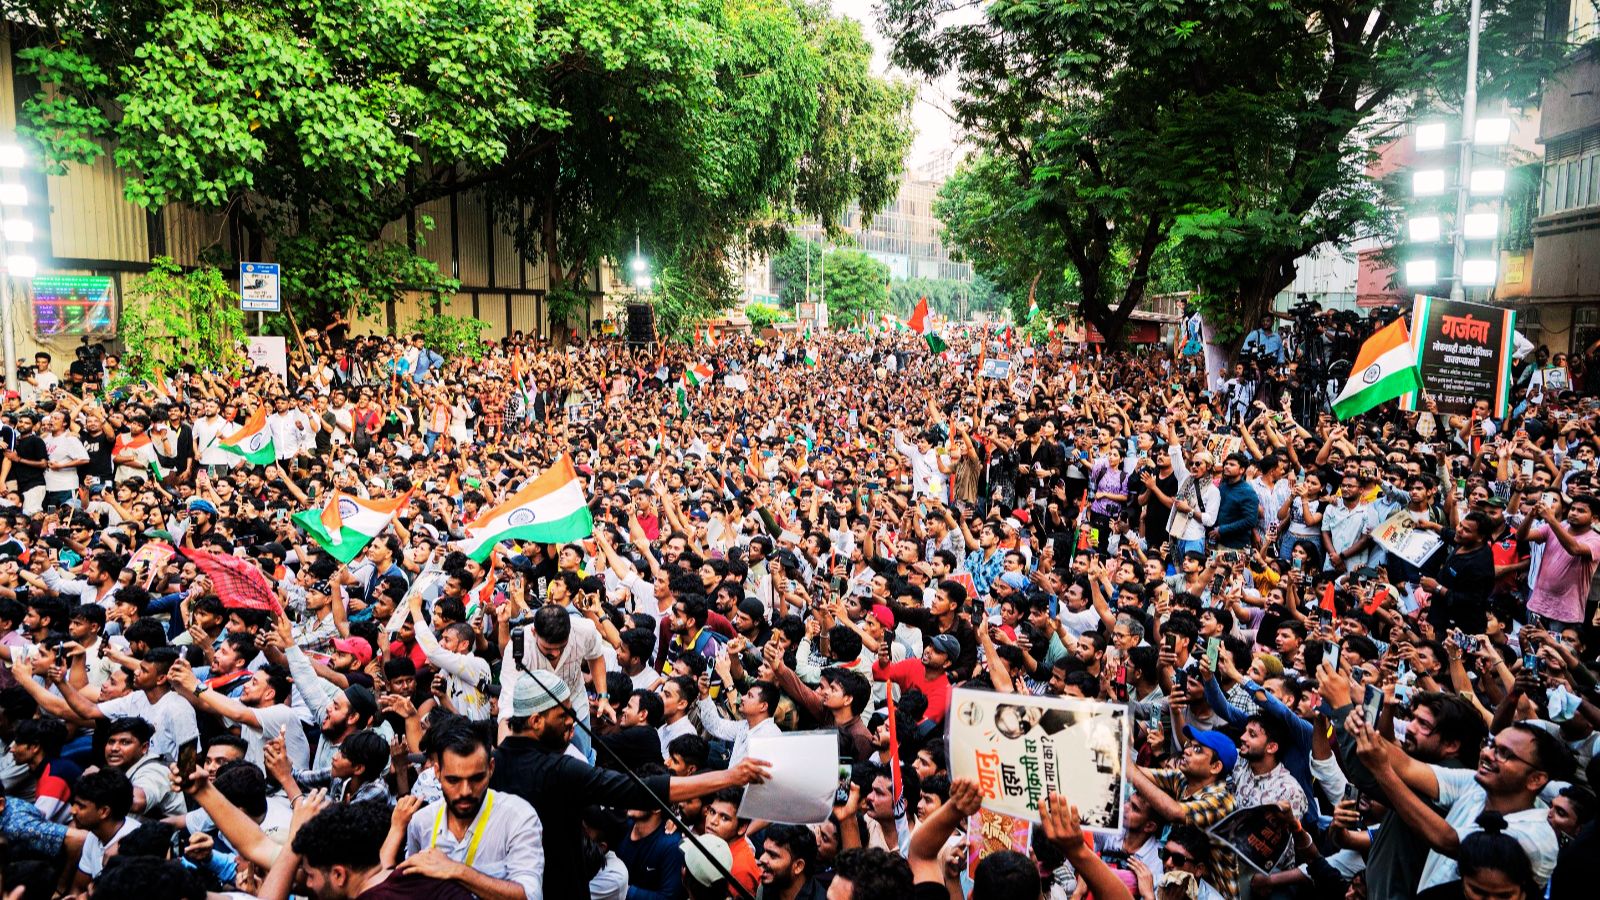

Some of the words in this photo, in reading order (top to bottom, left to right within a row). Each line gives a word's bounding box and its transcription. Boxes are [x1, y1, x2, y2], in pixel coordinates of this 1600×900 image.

[1441, 314, 1490, 344] गर्जना
[1432, 340, 1458, 354] लोकशाही
[1458, 344, 1472, 355] आणि
[1473, 345, 1493, 358] संविधान
[1025, 738, 1037, 753] वर
[1001, 763, 1023, 796] तुझा
[1044, 762, 1055, 781] नाय
